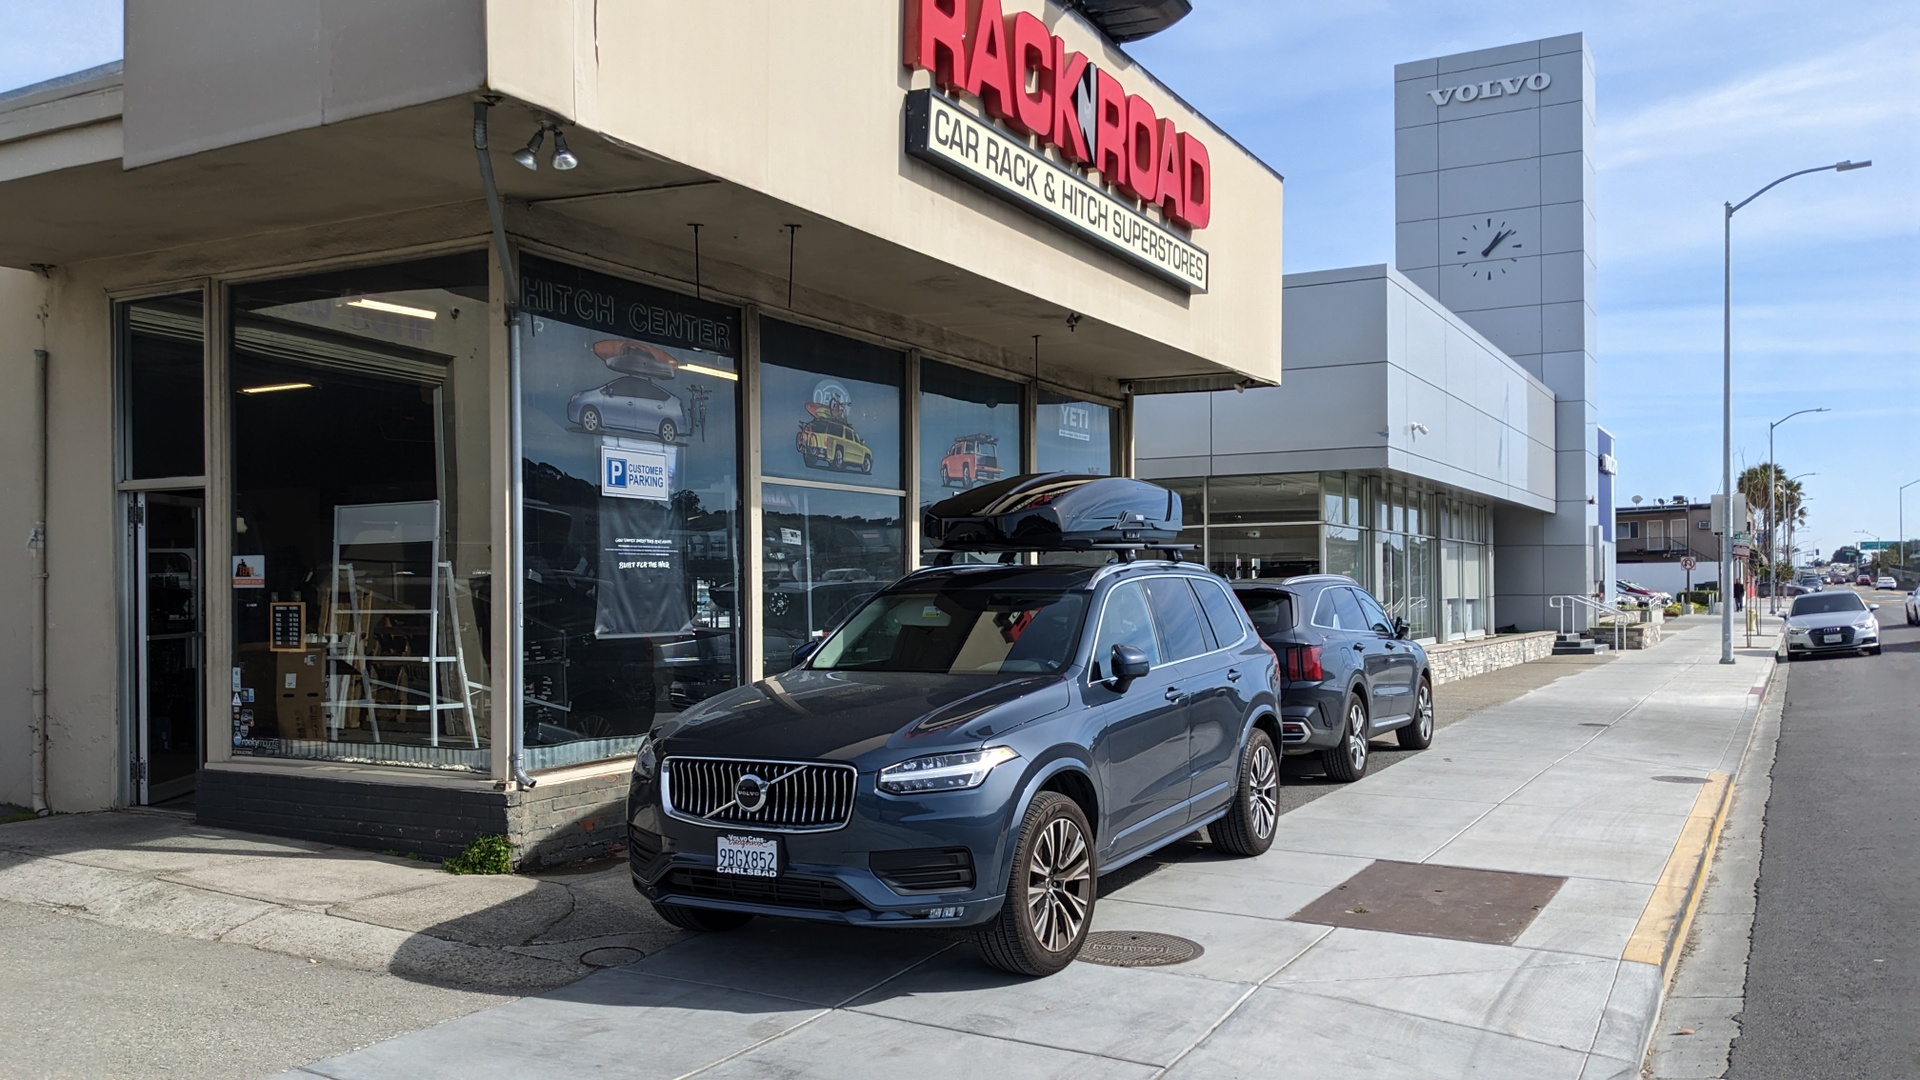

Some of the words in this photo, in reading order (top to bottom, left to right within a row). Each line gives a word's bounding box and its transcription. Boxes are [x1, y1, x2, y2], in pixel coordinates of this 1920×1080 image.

[1427, 72, 1551, 107] VOLVO
[904, 0, 1088, 164] RACK
[1096, 66, 1210, 230] ROAD
[934, 108, 979, 164] CAR
[986, 138, 1038, 195] RACK
[1044, 171, 1056, 204] &
[1062, 175, 1108, 232] HITCH
[1113, 209, 1203, 282] SUPERSTORES
[521, 276, 614, 325] HITCH
[628, 303, 730, 349] CENTER
[1060, 405, 1089, 429] YETI
[611, 461, 623, 485] P
[628, 463, 663, 476] CUSTOMER
[628, 474, 664, 488] PARKING
[719, 848, 775, 870] 9BGX852
[716, 866, 777, 877] CARLSBAD
